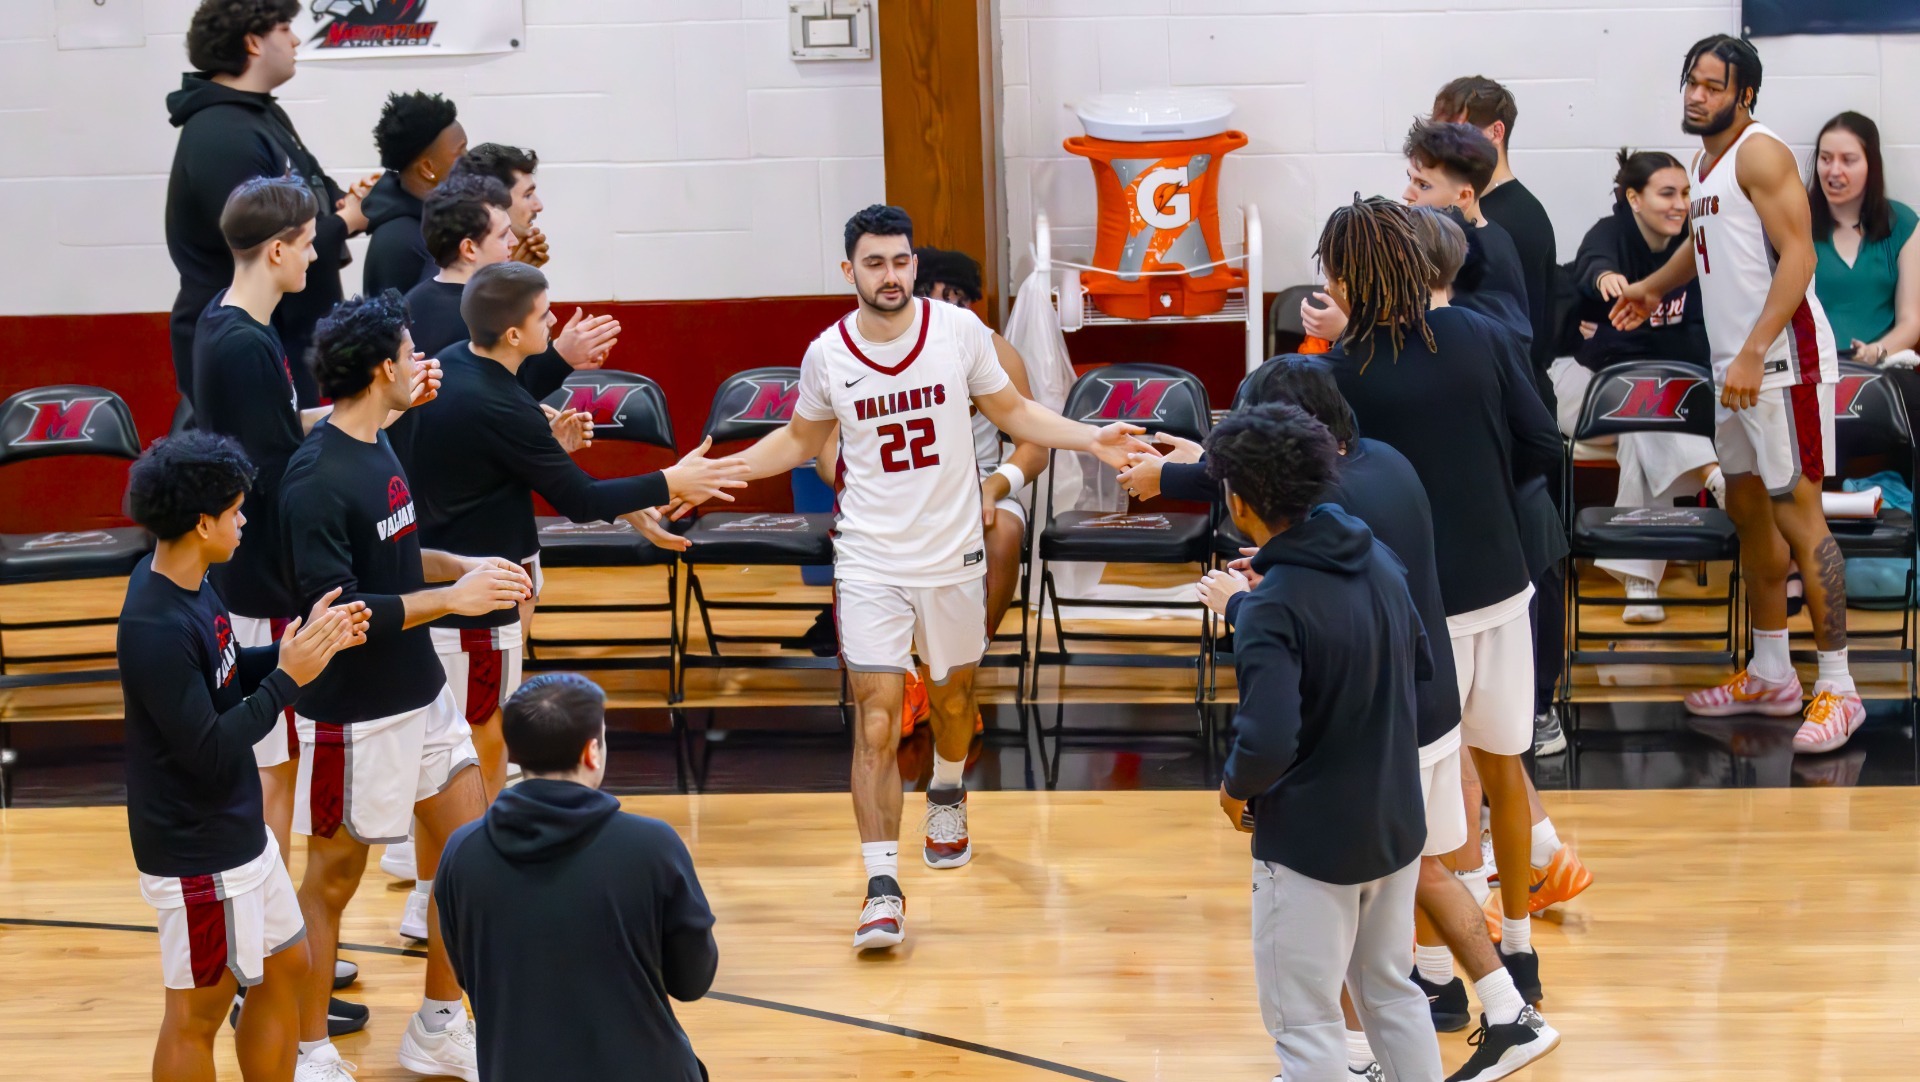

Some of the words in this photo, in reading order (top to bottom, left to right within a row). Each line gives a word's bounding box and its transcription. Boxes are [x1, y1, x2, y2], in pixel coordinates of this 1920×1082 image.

[1136, 166, 1191, 230] G
[1695, 225, 1710, 274] 4
[854, 383, 946, 421] VALIANTS
[876, 416, 940, 473] 22
